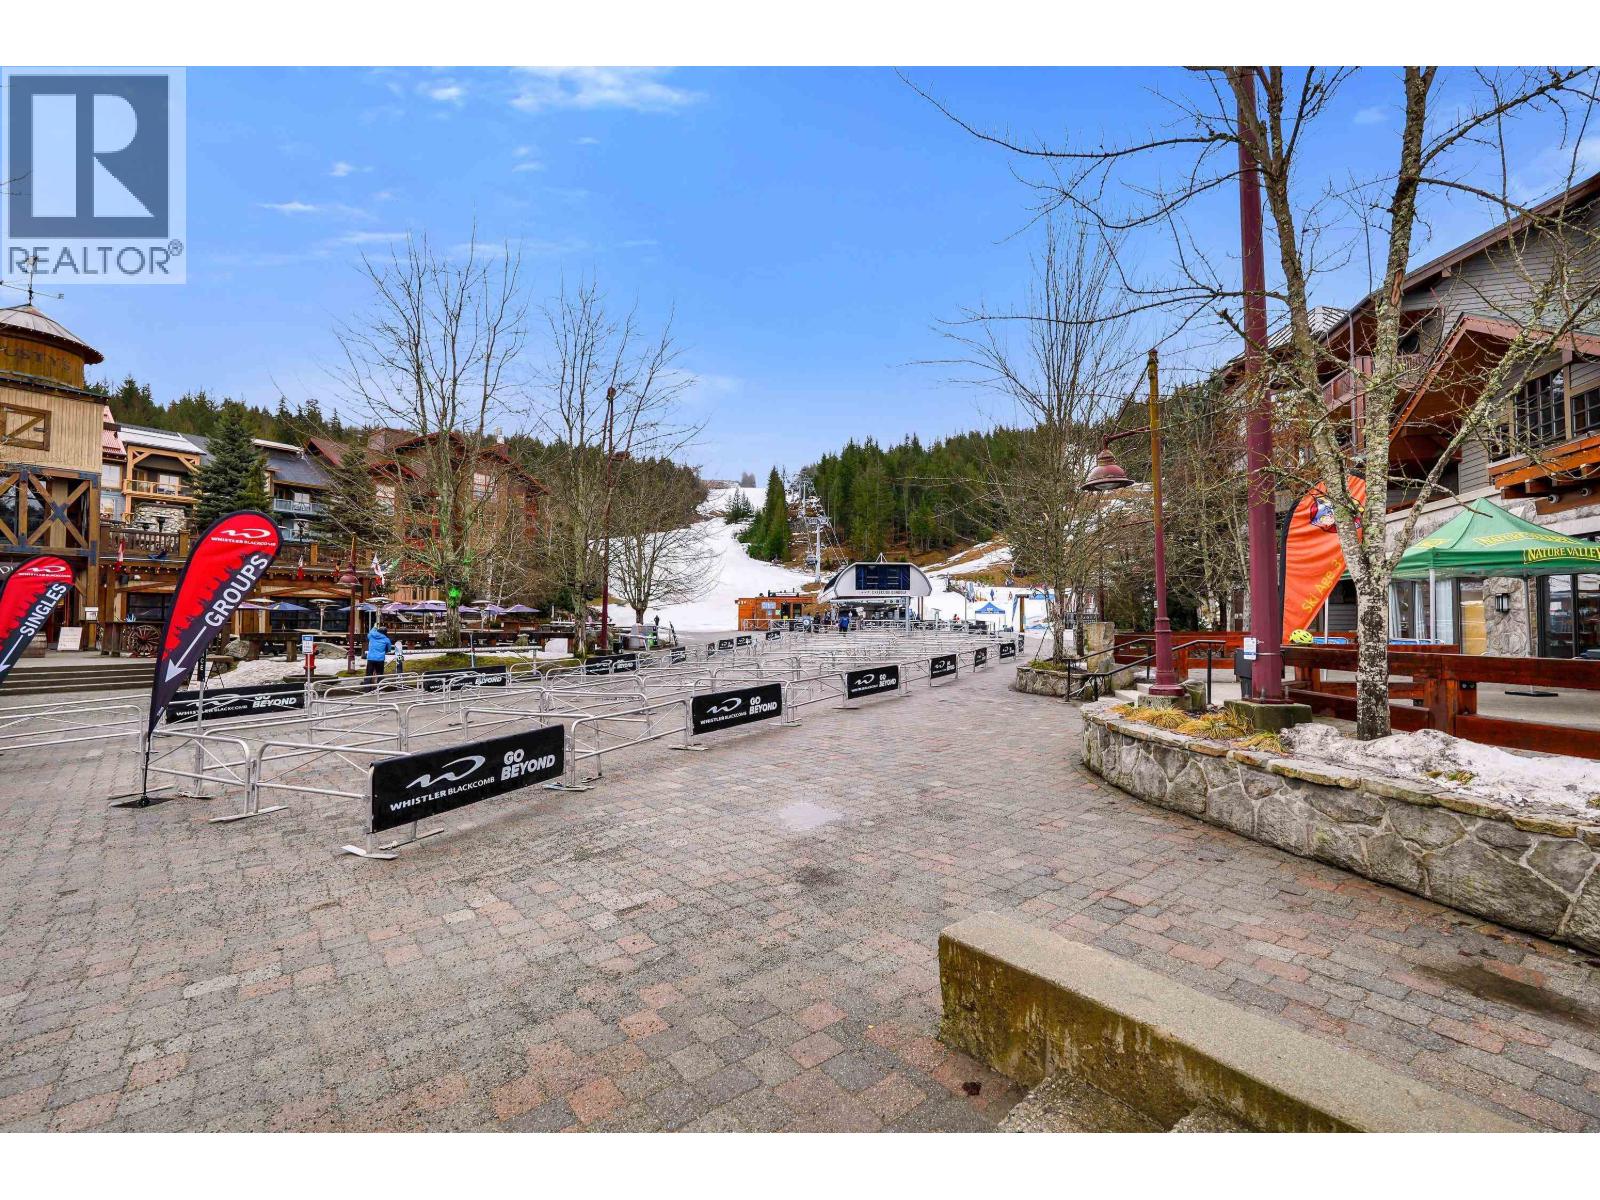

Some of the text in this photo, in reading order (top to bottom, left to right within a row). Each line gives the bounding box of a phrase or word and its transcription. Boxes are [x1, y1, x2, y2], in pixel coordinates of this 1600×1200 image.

[1528, 547, 1566, 562] NATURE
[205, 554, 268, 627] GROUPS
[20, 583, 67, 637] SINGLES
[252, 697, 297, 709] BEYOND
[749, 696, 761, 705] GO
[749, 701, 778, 715] BEYOND
[504, 749, 525, 765] GO
[501, 754, 556, 781] BEYOND
[390, 776, 495, 812] WHISTLER BLACKCOMB
